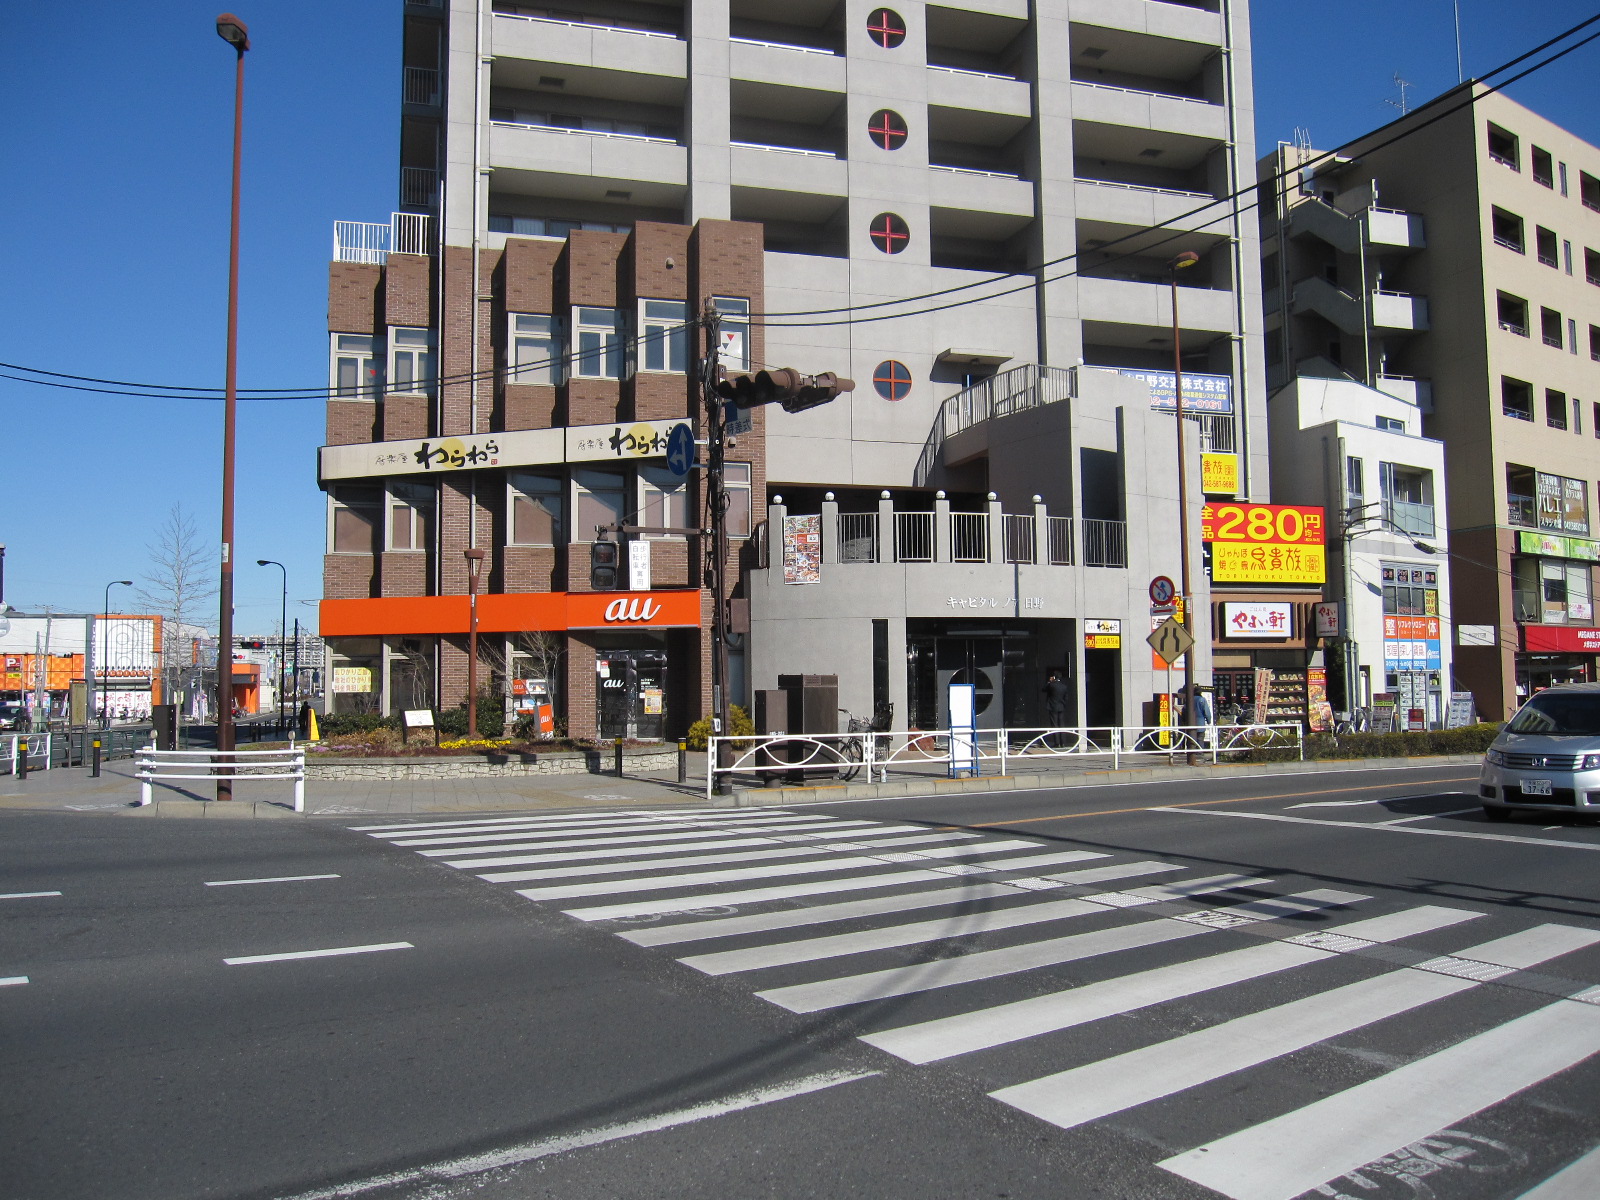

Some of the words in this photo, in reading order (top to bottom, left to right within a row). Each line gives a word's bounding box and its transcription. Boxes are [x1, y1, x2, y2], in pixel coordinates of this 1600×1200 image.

[414, 439, 499, 469] わらわら
[1217, 506, 1304, 542] 280
[1303, 514, 1321, 529] 円
[1250, 546, 1302, 572] 鳥貴族
[604, 597, 662, 621] au
[1232, 610, 1286, 630] やよい軒
[603, 679, 624, 688] au
[540, 714, 551, 724] au
